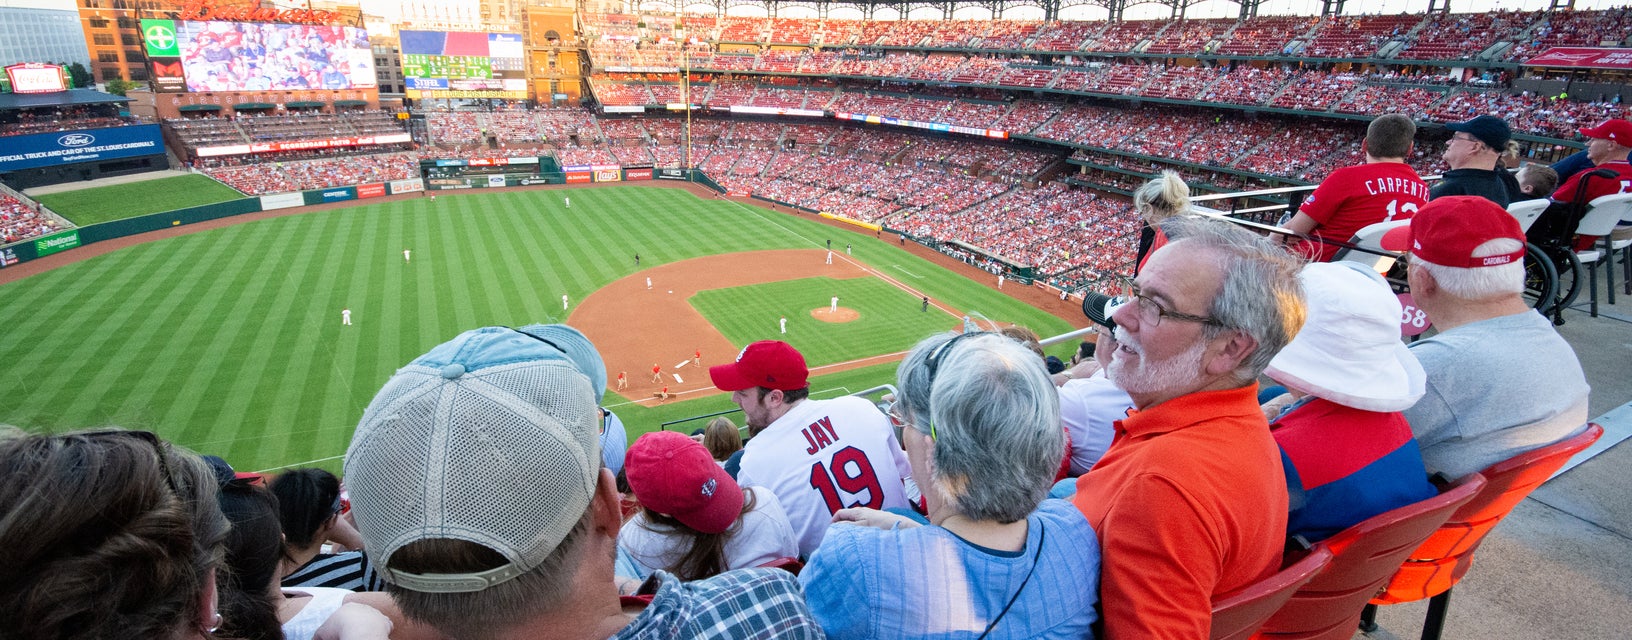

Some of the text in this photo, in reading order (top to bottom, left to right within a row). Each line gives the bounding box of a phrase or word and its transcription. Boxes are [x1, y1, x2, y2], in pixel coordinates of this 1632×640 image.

[0, 154, 25, 162] FFICIAL
[24, 151, 47, 160] TRUCK
[105, 143, 124, 151] LOUIS
[123, 140, 155, 149] CARDINALS
[64, 135, 89, 146] Ford
[280, 140, 328, 150] SCOREBOARD
[1365, 176, 1431, 203] CARPENTE
[47, 233, 77, 247] National
[1483, 255, 1511, 266] CARDINALS
[1401, 305, 1427, 329] 58
[801, 415, 840, 456] JAY
[809, 445, 885, 518] 19
